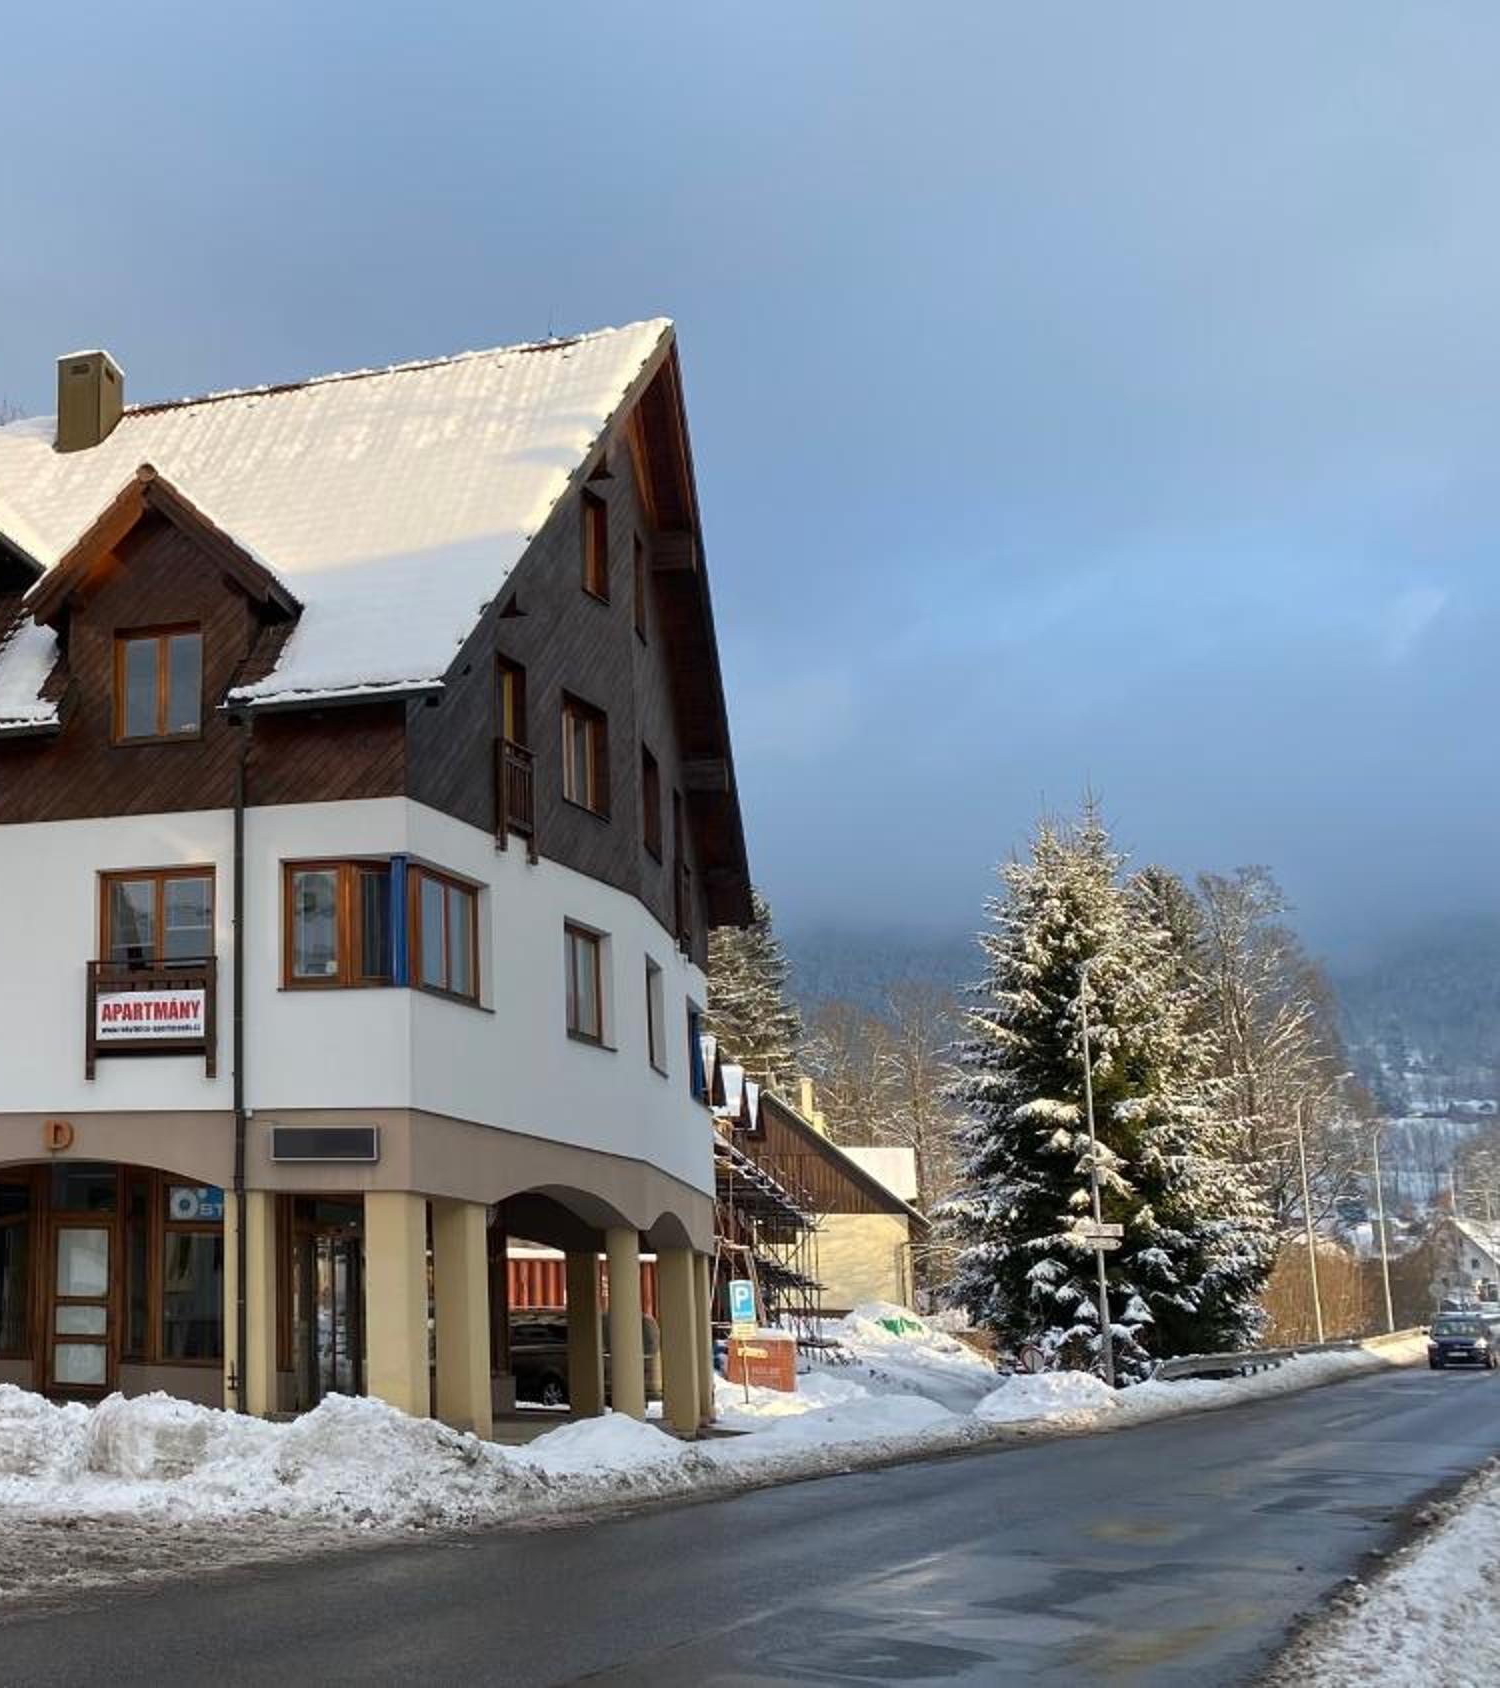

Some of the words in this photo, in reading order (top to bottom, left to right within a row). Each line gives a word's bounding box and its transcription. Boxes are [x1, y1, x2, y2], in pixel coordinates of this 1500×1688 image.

[101, 998, 201, 1022] APARTMÁNY
[43, 1119, 75, 1152] D
[735, 1287, 749, 1310] P
